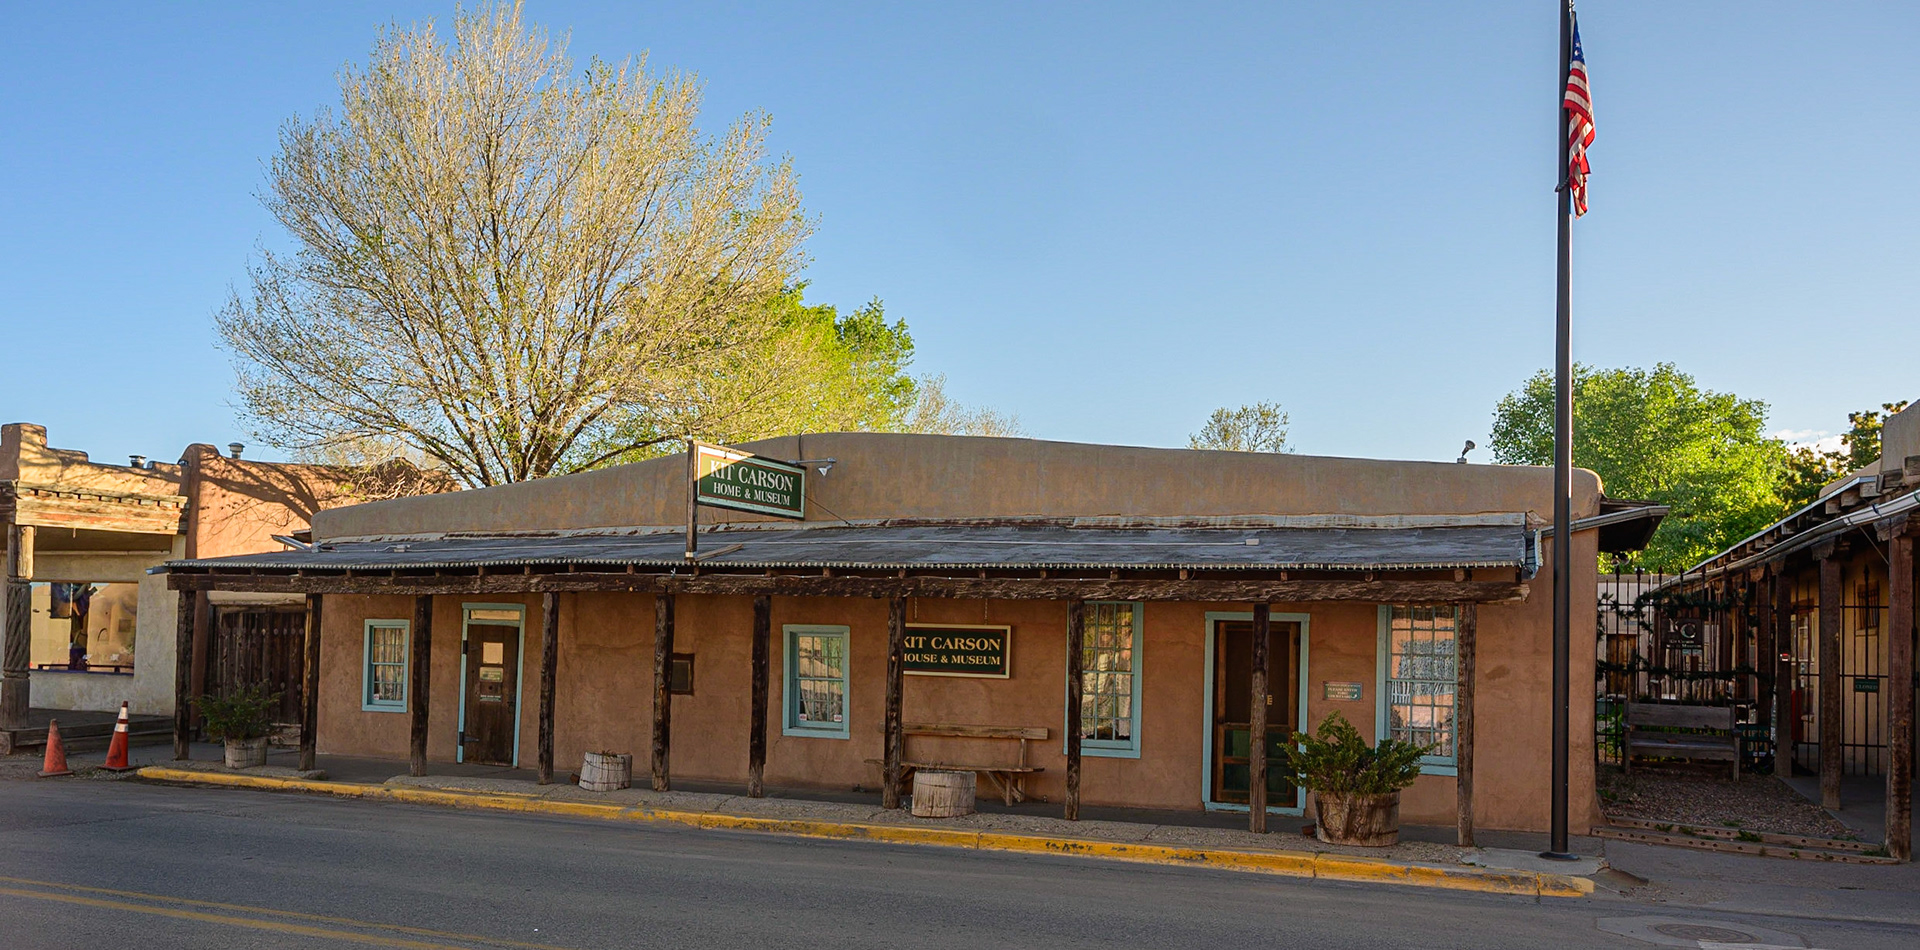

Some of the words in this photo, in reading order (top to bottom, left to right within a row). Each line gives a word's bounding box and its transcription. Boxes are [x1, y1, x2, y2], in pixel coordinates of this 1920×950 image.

[710, 460, 735, 480] KIT
[738, 466, 794, 492] CARSON
[713, 482, 741, 497] HOME
[744, 488, 751, 499] &
[754, 489, 790, 506] MUSEUM
[931, 637, 1001, 651] CARSON
[940, 655, 948, 664] &
[951, 655, 1001, 665] MUSEUM
